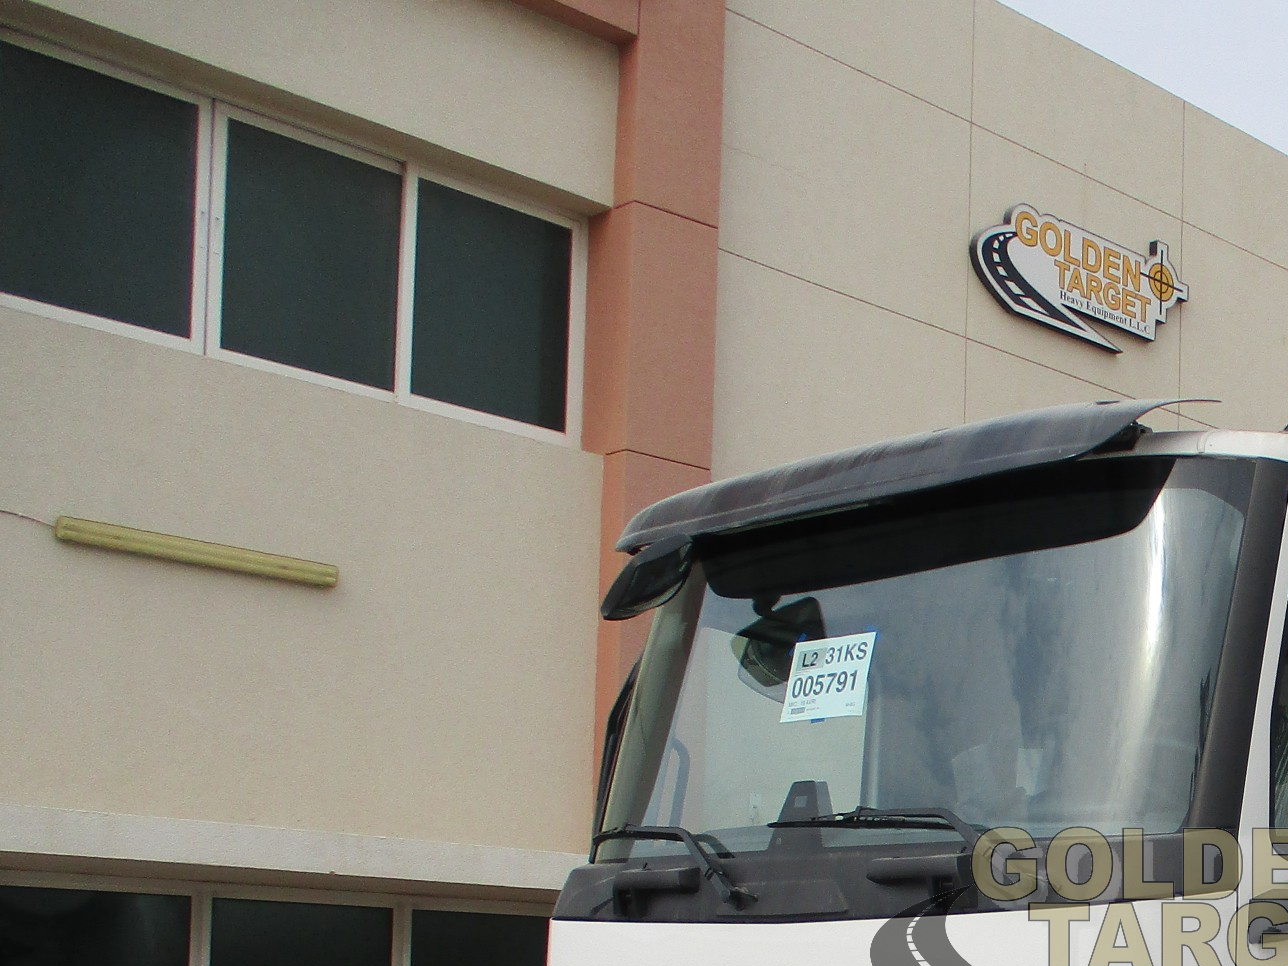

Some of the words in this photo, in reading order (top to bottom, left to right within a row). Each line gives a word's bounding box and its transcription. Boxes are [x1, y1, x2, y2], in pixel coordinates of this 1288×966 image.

[1015, 211, 1141, 292] GOLDEN
[1054, 259, 1151, 322] TARGET
[1060, 290, 1084, 308] Heavy
[1086, 301, 1127, 326] Equipment
[801, 652, 819, 668] L2
[825, 641, 869, 665] 31KS
[791, 669, 859, 699] 005791
